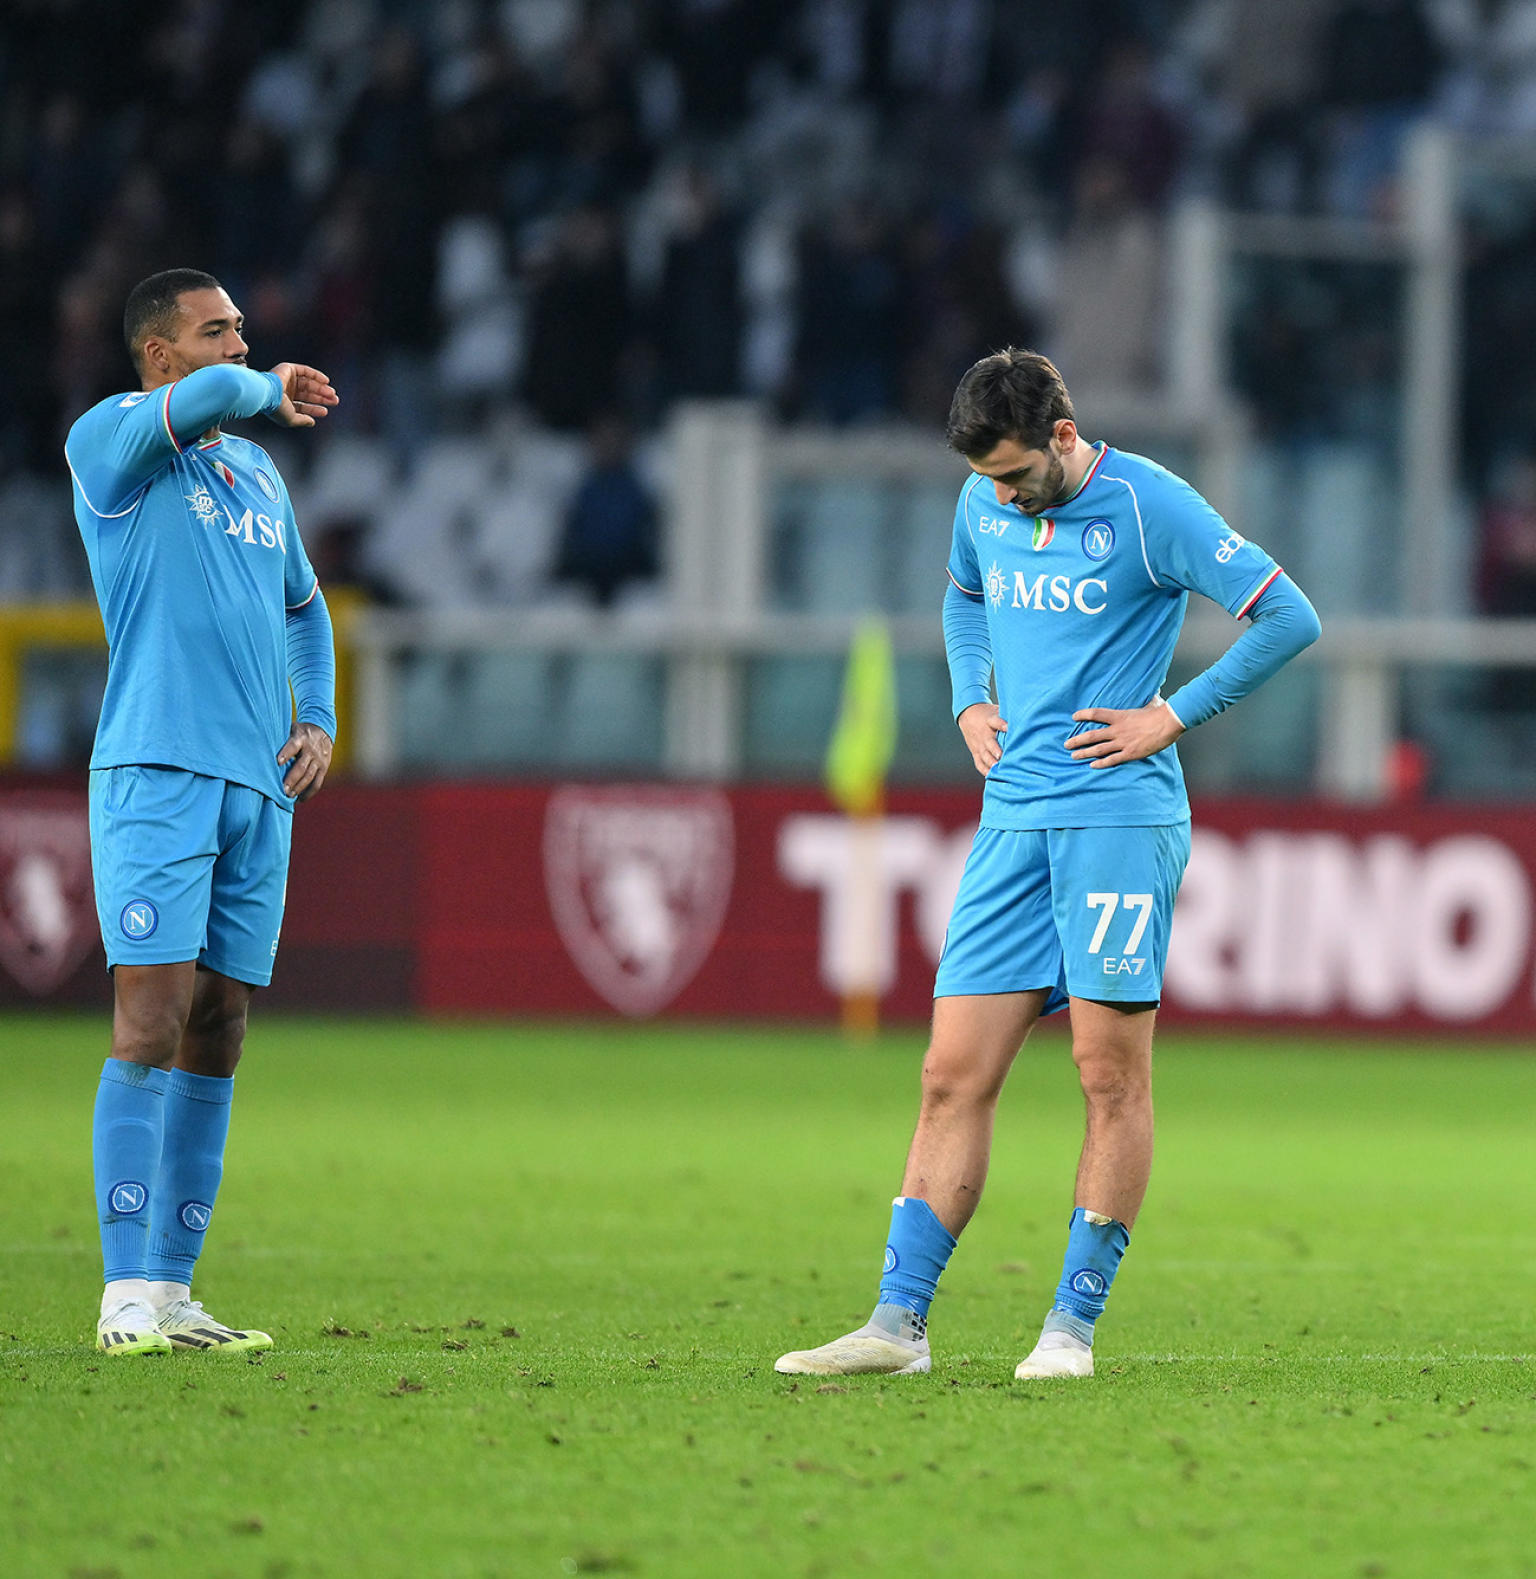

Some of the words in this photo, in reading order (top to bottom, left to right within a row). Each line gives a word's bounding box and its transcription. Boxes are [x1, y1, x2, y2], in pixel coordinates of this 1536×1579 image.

[979, 516, 1010, 537] EA7
[1011, 571, 1108, 615] MSC
[1086, 892, 1154, 956] 77
[1103, 957, 1146, 976] EA7
